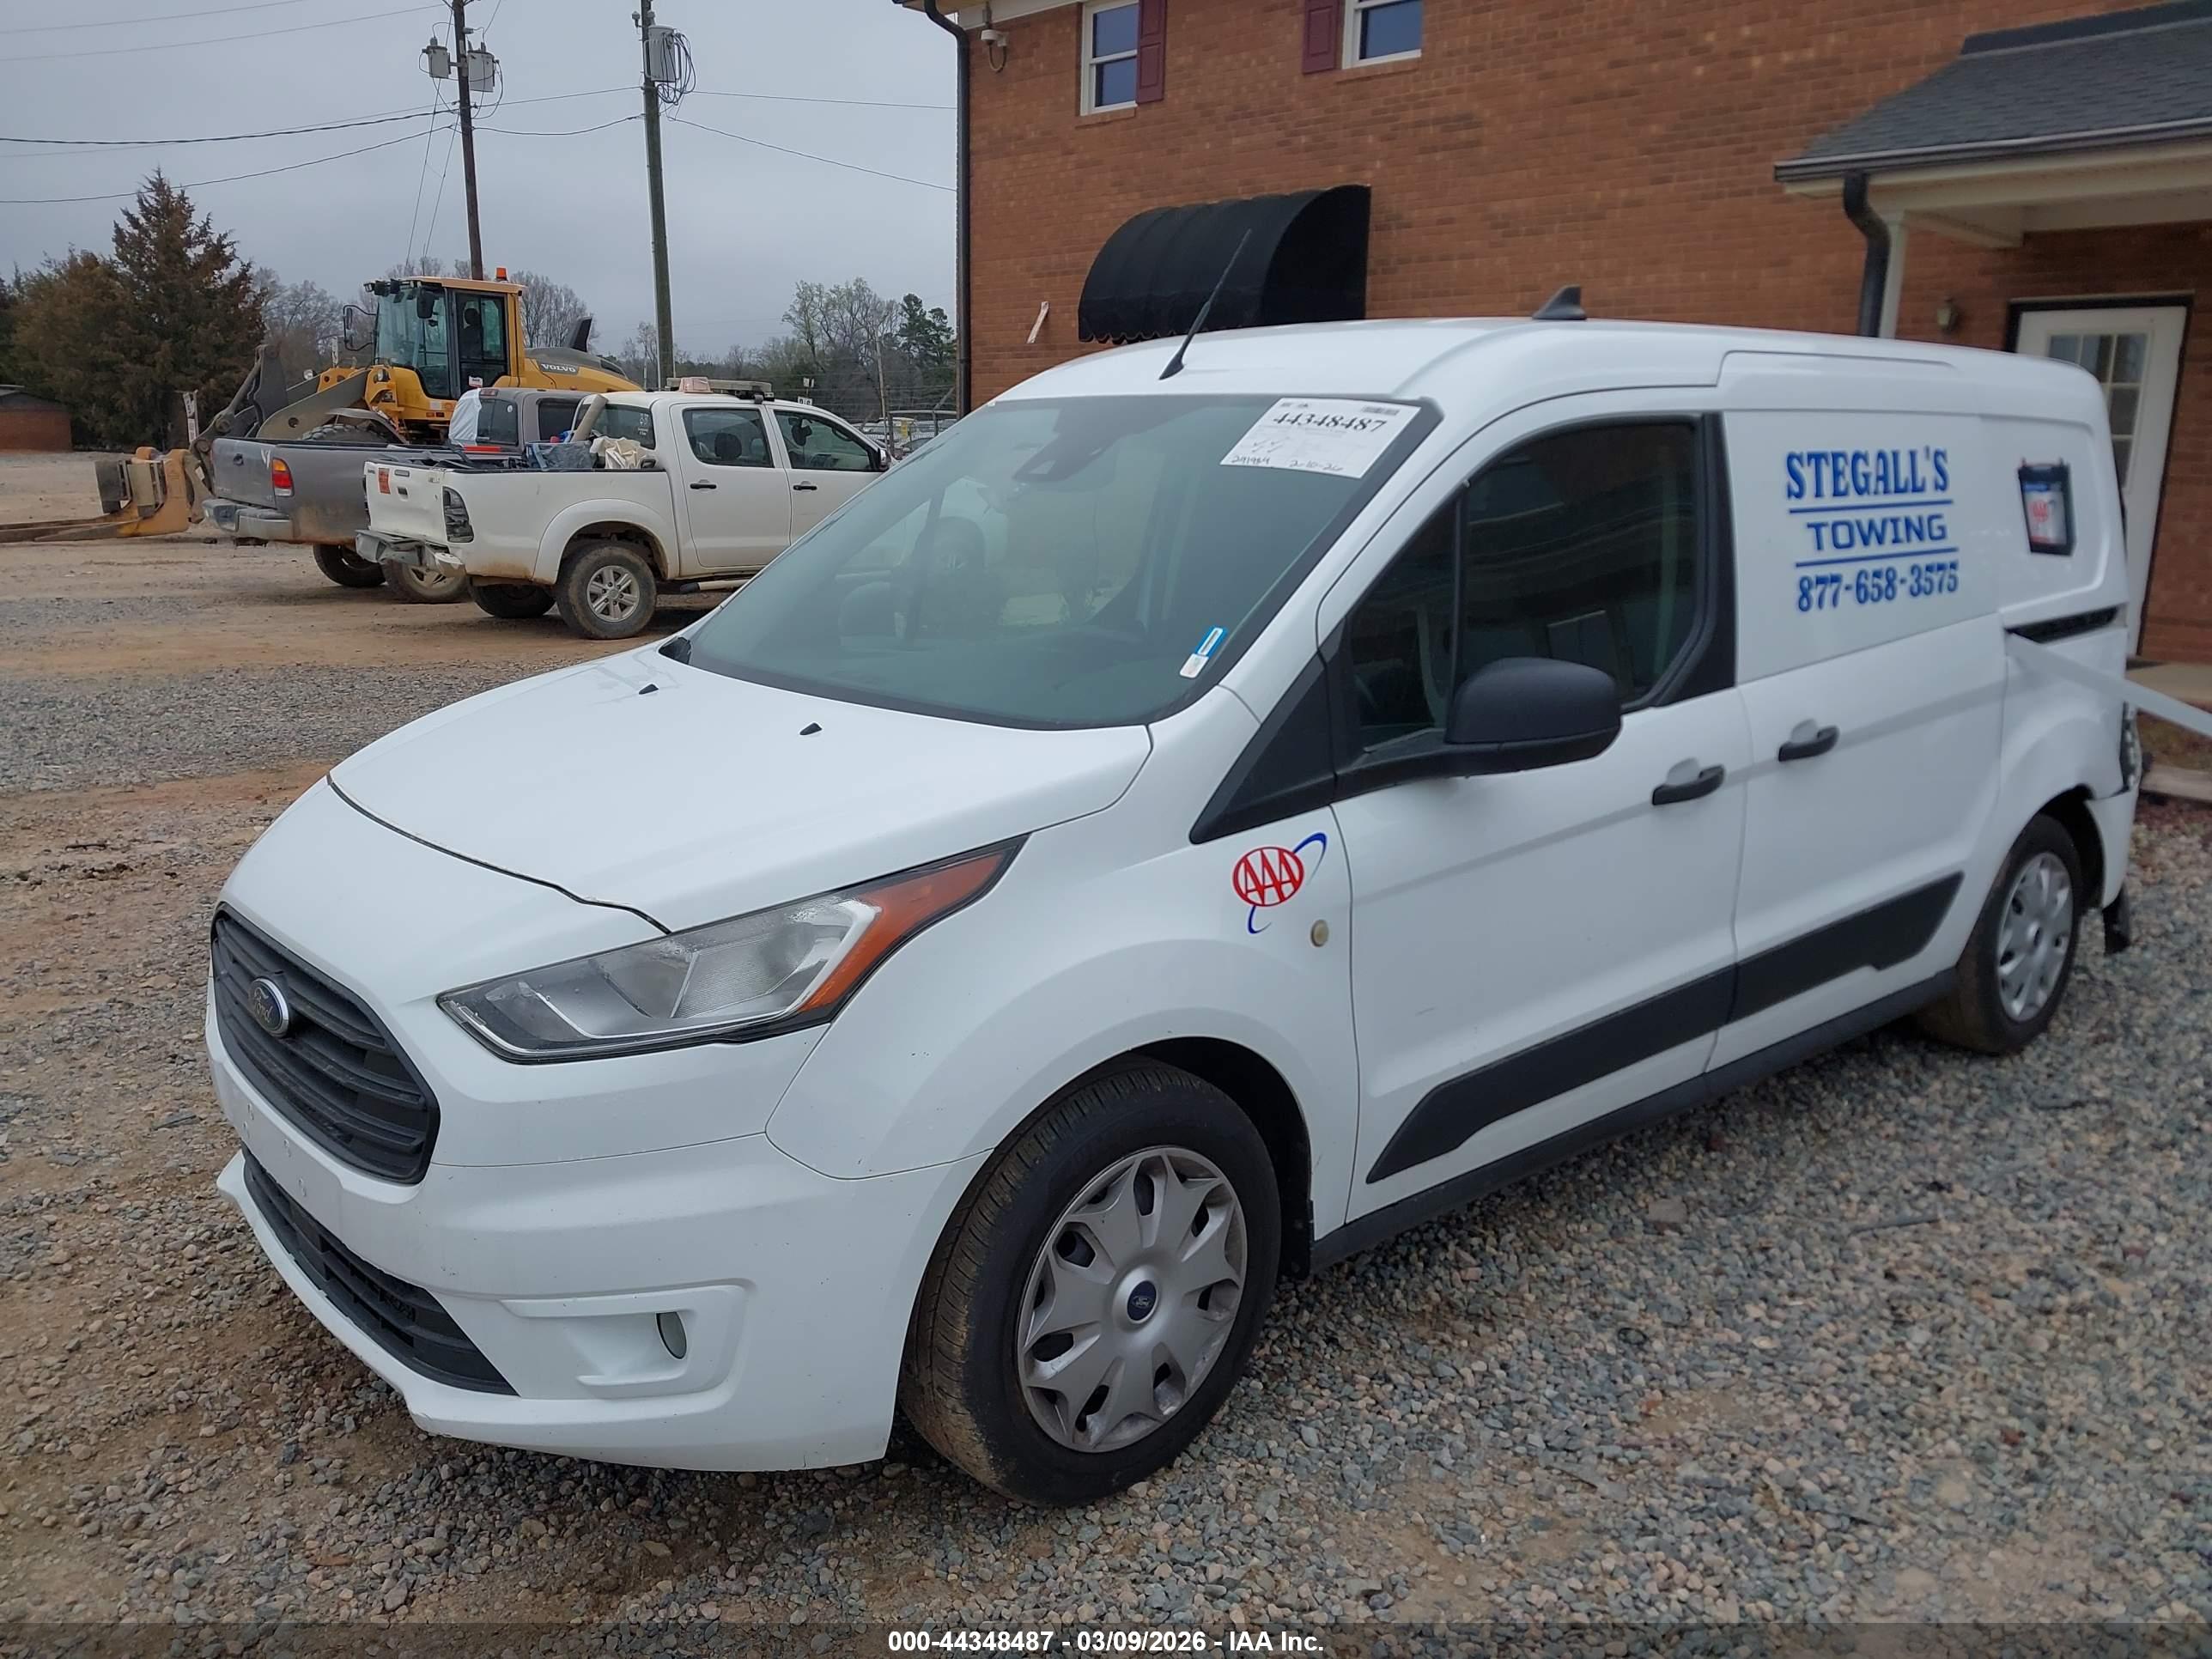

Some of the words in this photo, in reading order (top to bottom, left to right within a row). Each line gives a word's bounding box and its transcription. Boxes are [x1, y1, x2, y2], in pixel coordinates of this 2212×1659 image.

[541, 363, 576, 373] VOLVO
[1273, 412, 1388, 432] 44348487
[1786, 446, 1948, 500] STEGALL'S
[1807, 514, 1948, 551] TOWING
[1797, 560, 1959, 612] 877-658-3575
[1235, 847, 1303, 906] AAA
